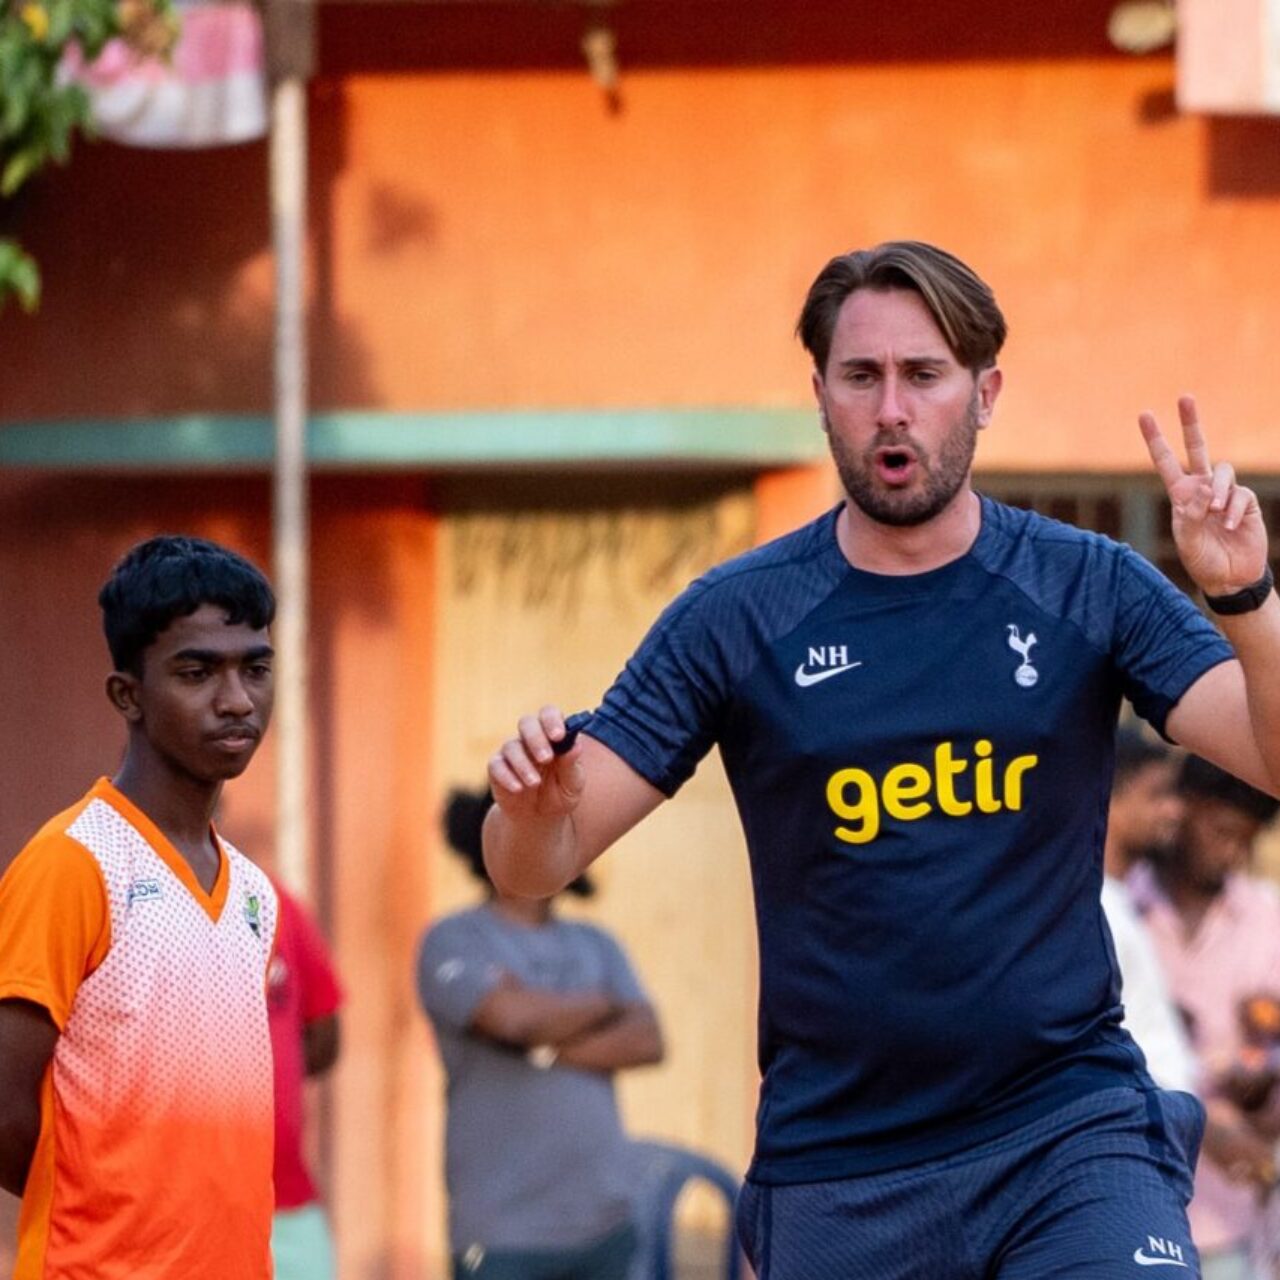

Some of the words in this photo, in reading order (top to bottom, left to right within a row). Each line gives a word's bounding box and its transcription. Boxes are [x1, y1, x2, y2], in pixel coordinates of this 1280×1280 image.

[808, 646, 848, 667] NH
[826, 739, 1039, 844] getir
[1147, 1235, 1184, 1262] NH
